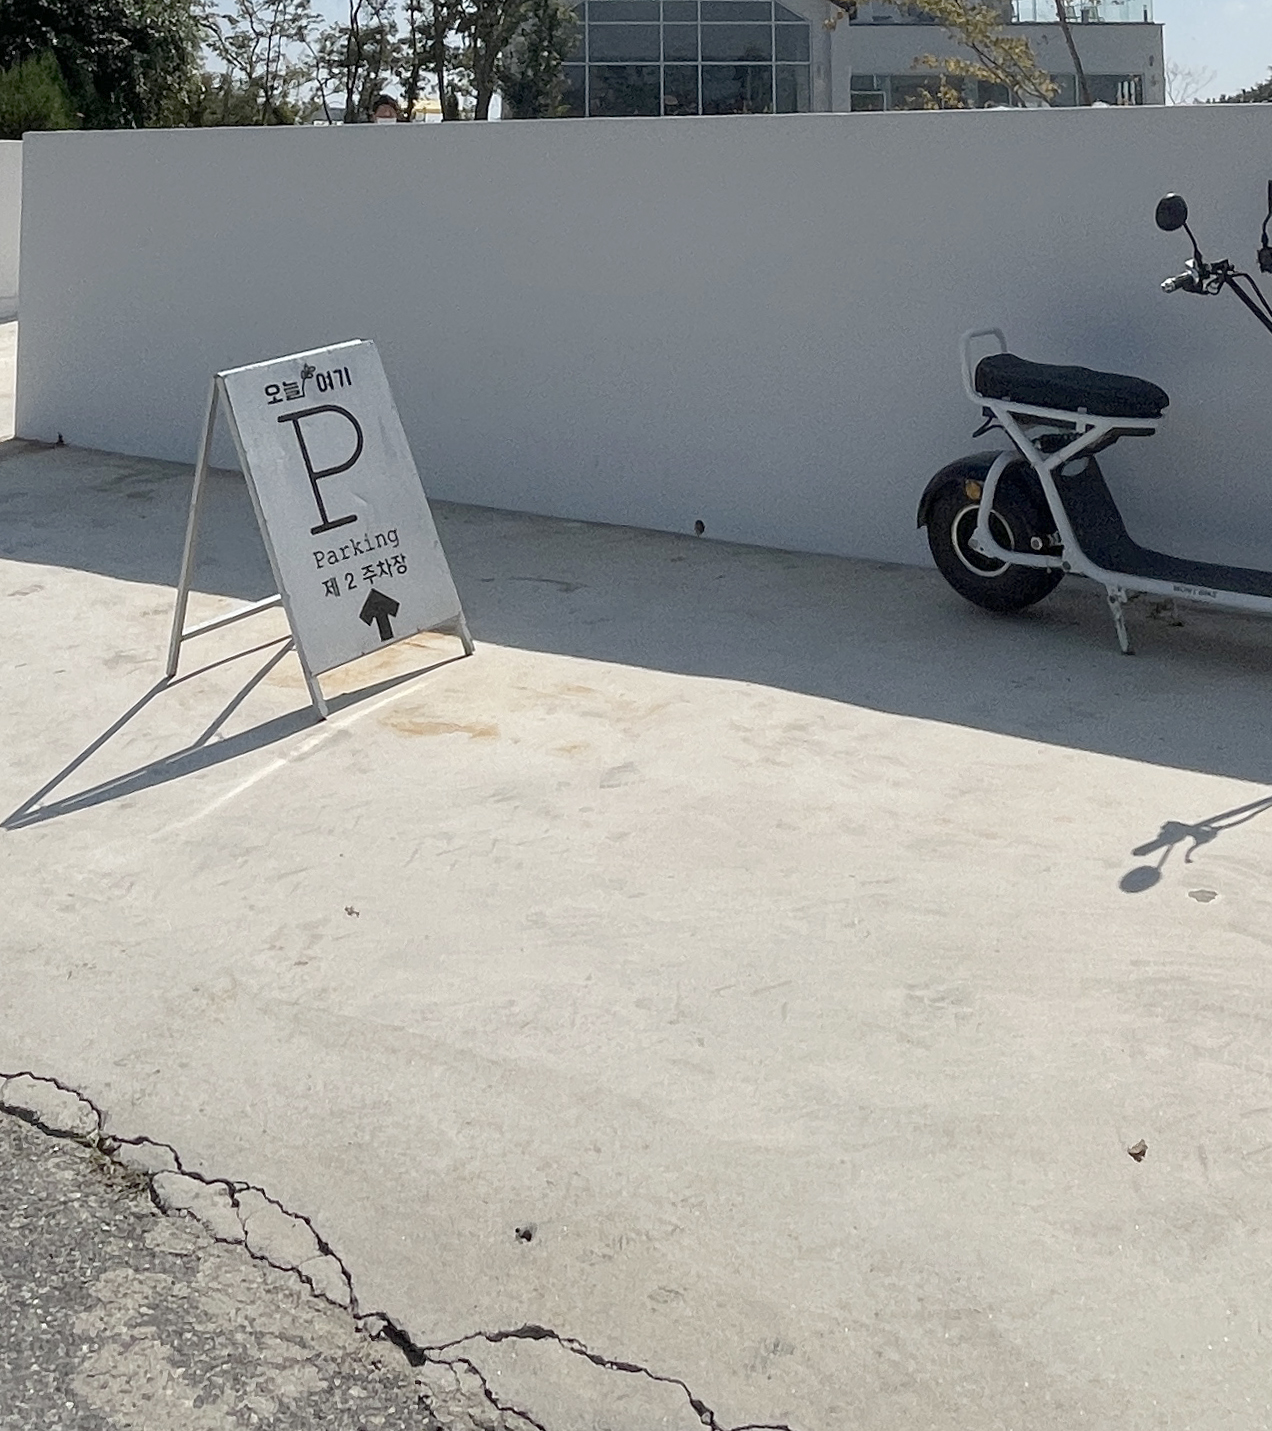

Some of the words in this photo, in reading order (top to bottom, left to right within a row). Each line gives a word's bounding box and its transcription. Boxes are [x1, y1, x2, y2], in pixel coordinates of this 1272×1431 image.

[277, 403, 364, 536] P
[312, 527, 401, 570] Parking
[344, 572, 358, 591] 2
[360, 552, 408, 585] 주차장
